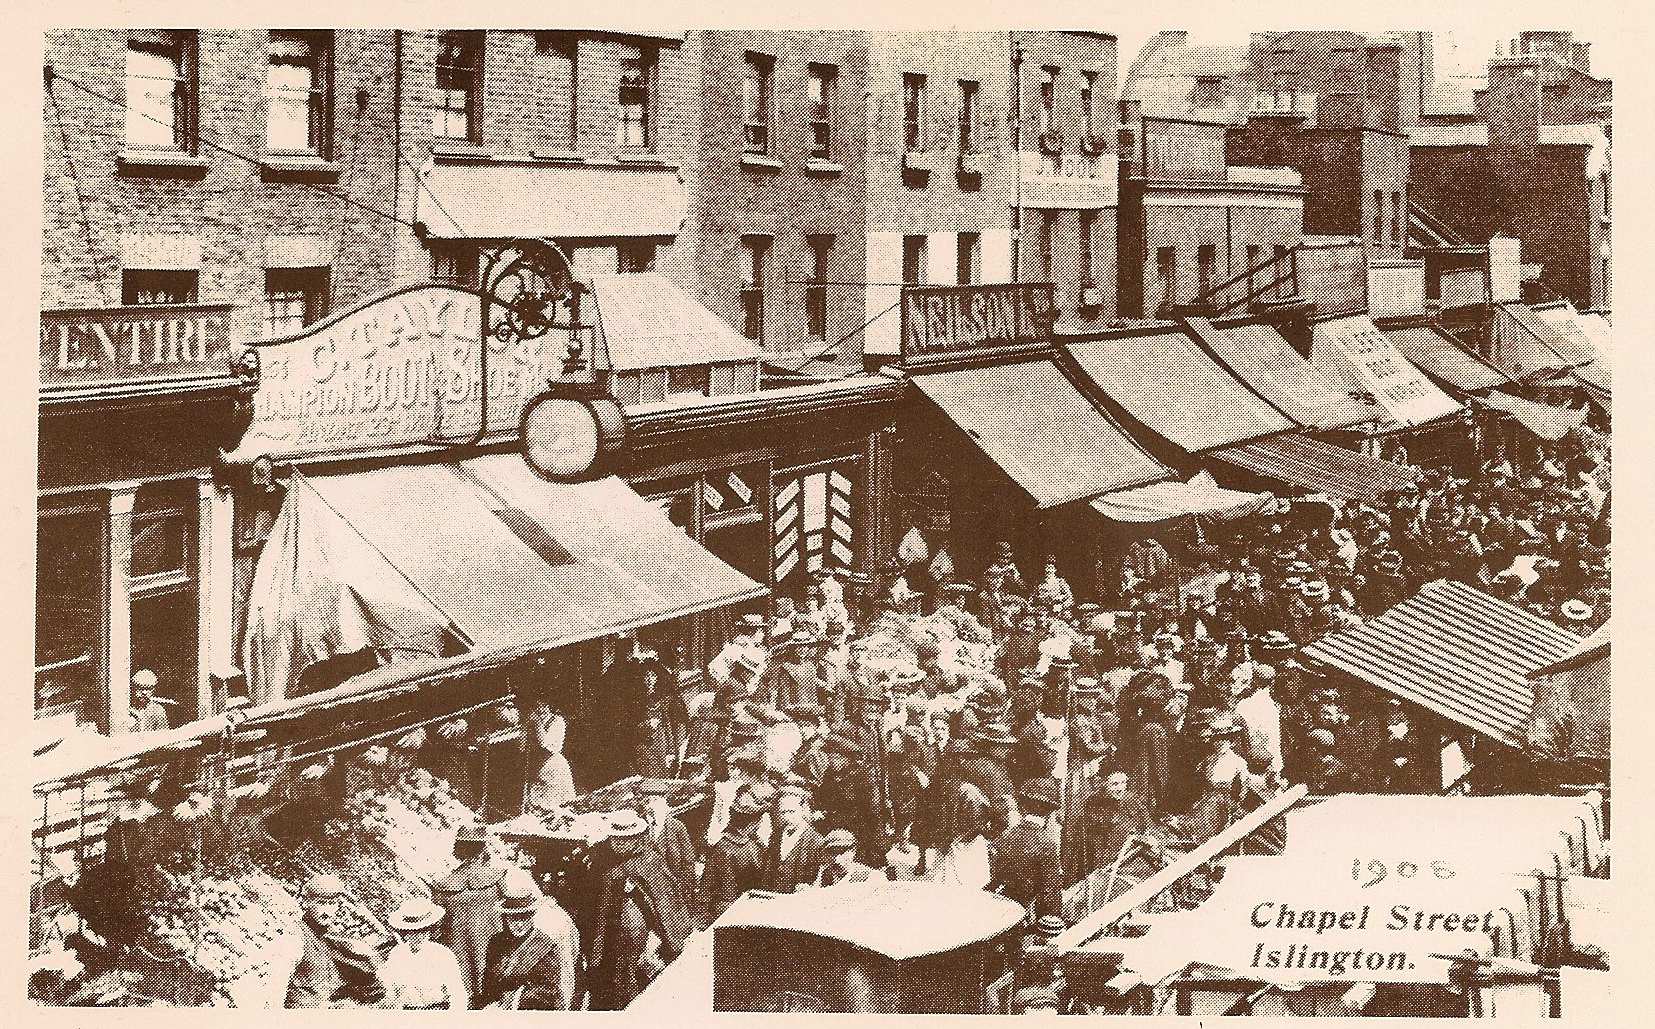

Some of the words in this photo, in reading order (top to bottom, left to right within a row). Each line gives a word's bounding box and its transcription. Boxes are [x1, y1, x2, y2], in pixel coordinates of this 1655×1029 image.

[57, 316, 229, 370] ENTIRE
[907, 290, 1015, 353] NEILSON
[254, 383, 359, 422] HAMPION
[360, 352, 433, 414] BOOT
